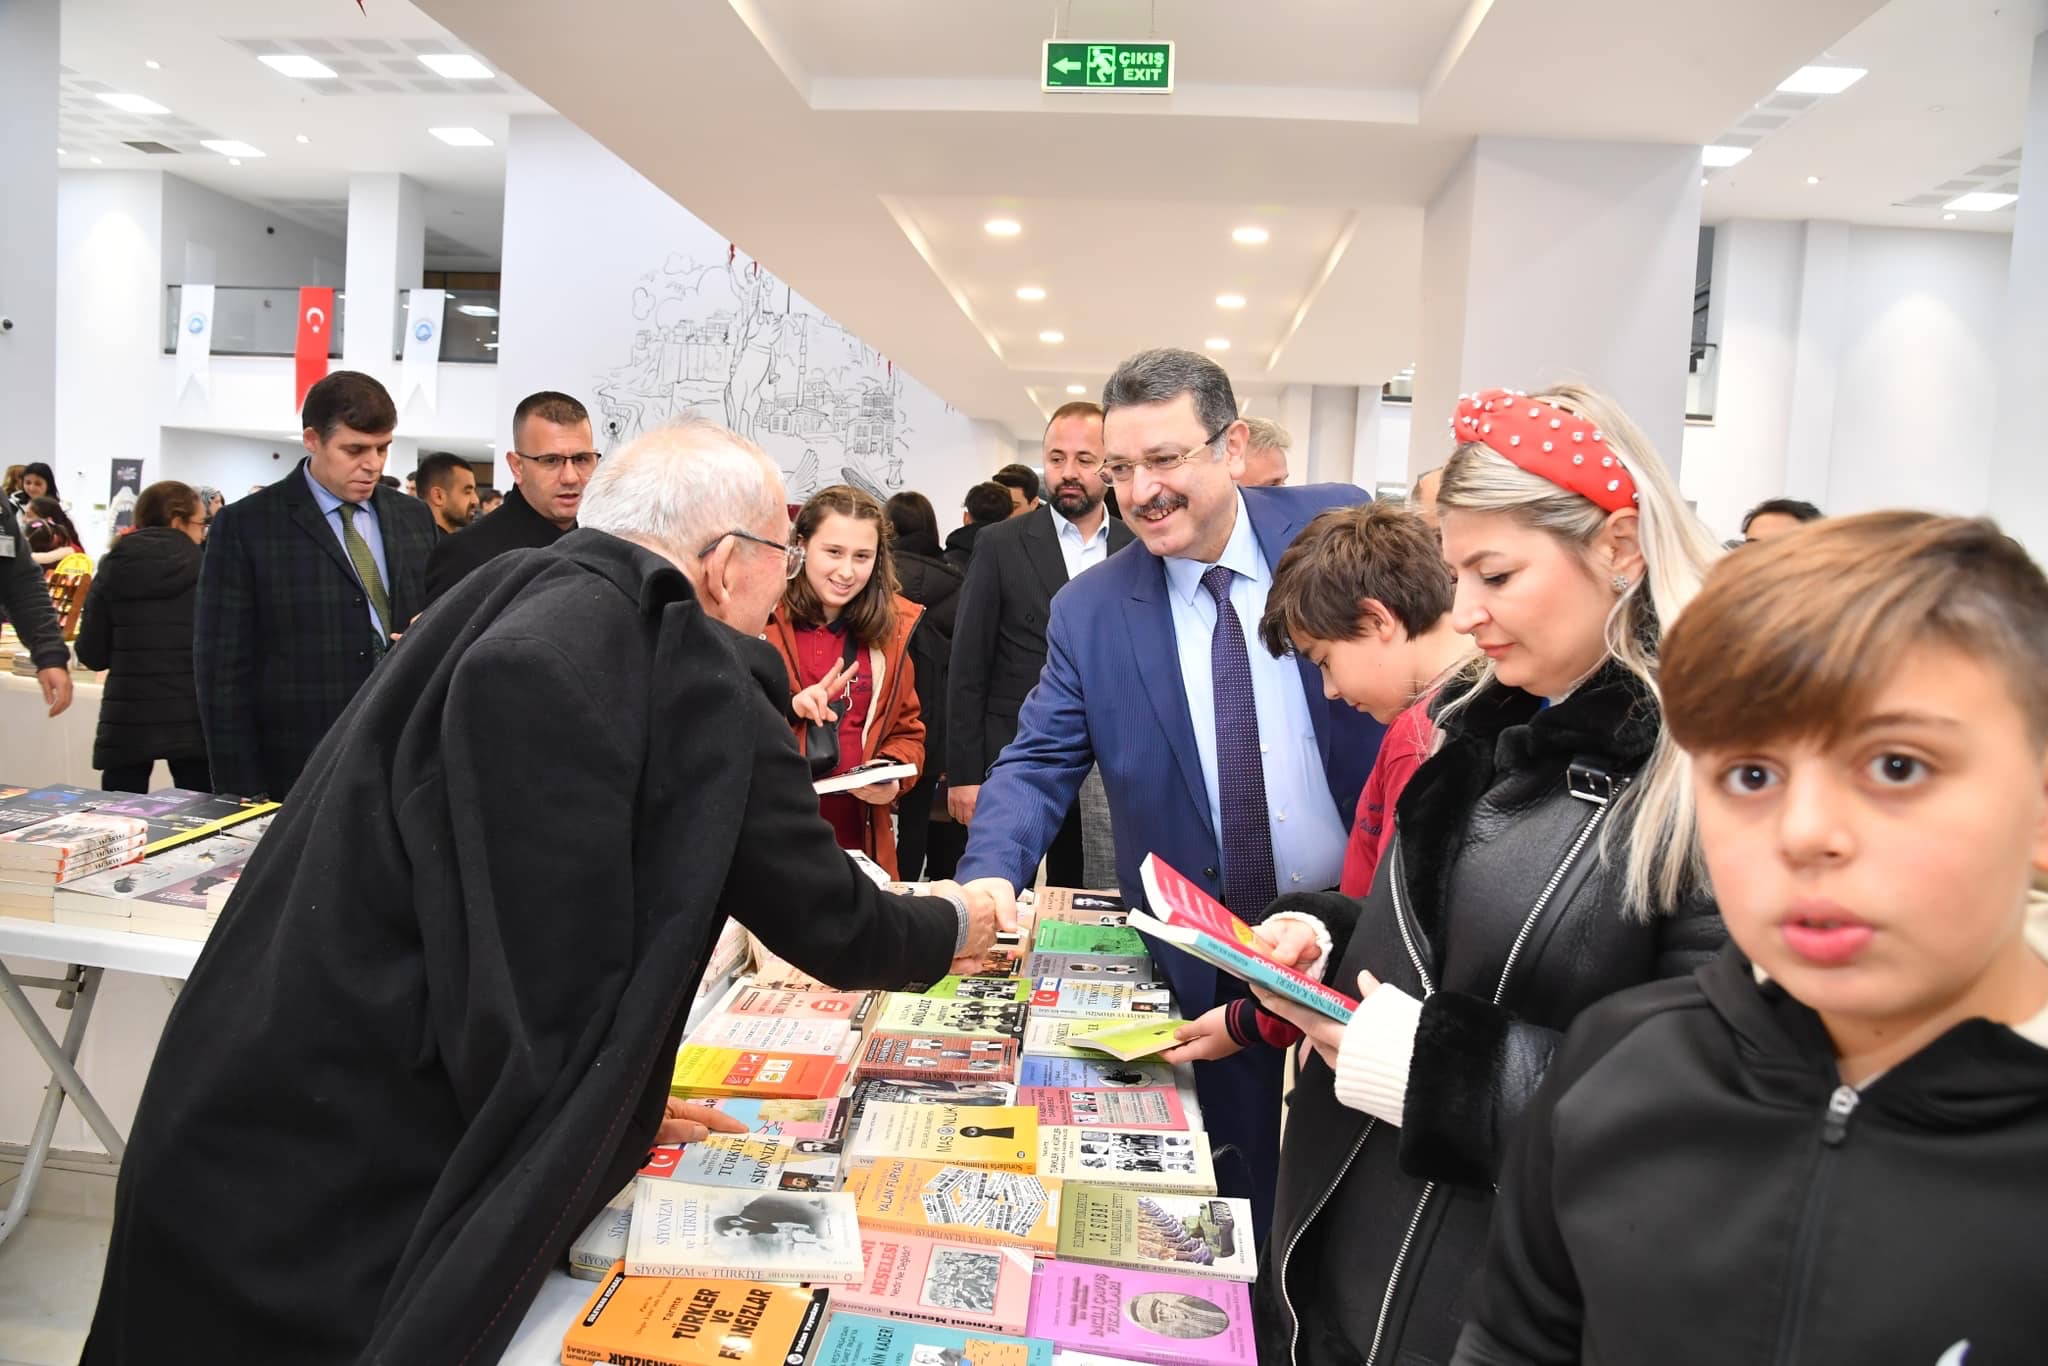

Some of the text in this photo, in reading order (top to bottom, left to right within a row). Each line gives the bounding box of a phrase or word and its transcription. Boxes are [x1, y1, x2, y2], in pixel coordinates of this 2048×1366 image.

[1119, 52, 1165, 67] ÇIKIŞ
[1123, 68, 1162, 81] EXIT
[1276, 975, 1352, 1021] RKİYE'NİN KADERİ
[911, 999, 932, 1026] ABDÜLAZİZ
[718, 1137, 747, 1176] TÜRKİYE
[749, 1138, 780, 1184] SİYONİZM
[878, 1189, 895, 1213] YALAN
[608, 1203, 634, 1239] SİYON
[656, 1199, 673, 1246] SİYONİZM
[680, 1199, 697, 1239] TÜRKİYE
[1090, 1202, 1109, 1229] ŞUBAT
[578, 1252, 613, 1268] SİYON
[634, 1262, 696, 1278] SİYONİZM
[712, 1266, 764, 1280] TÜRKİYE
[870, 1241, 899, 1296] MESELESİ
[662, 1296, 684, 1322] Tarihte
[672, 1288, 721, 1339] TÜRKLER
[709, 1309, 735, 1323] ve
[889, 1310, 948, 1324] Meselesi
[875, 1325, 896, 1352] KADERİ
[950, 1318, 1004, 1332] Ermeni
